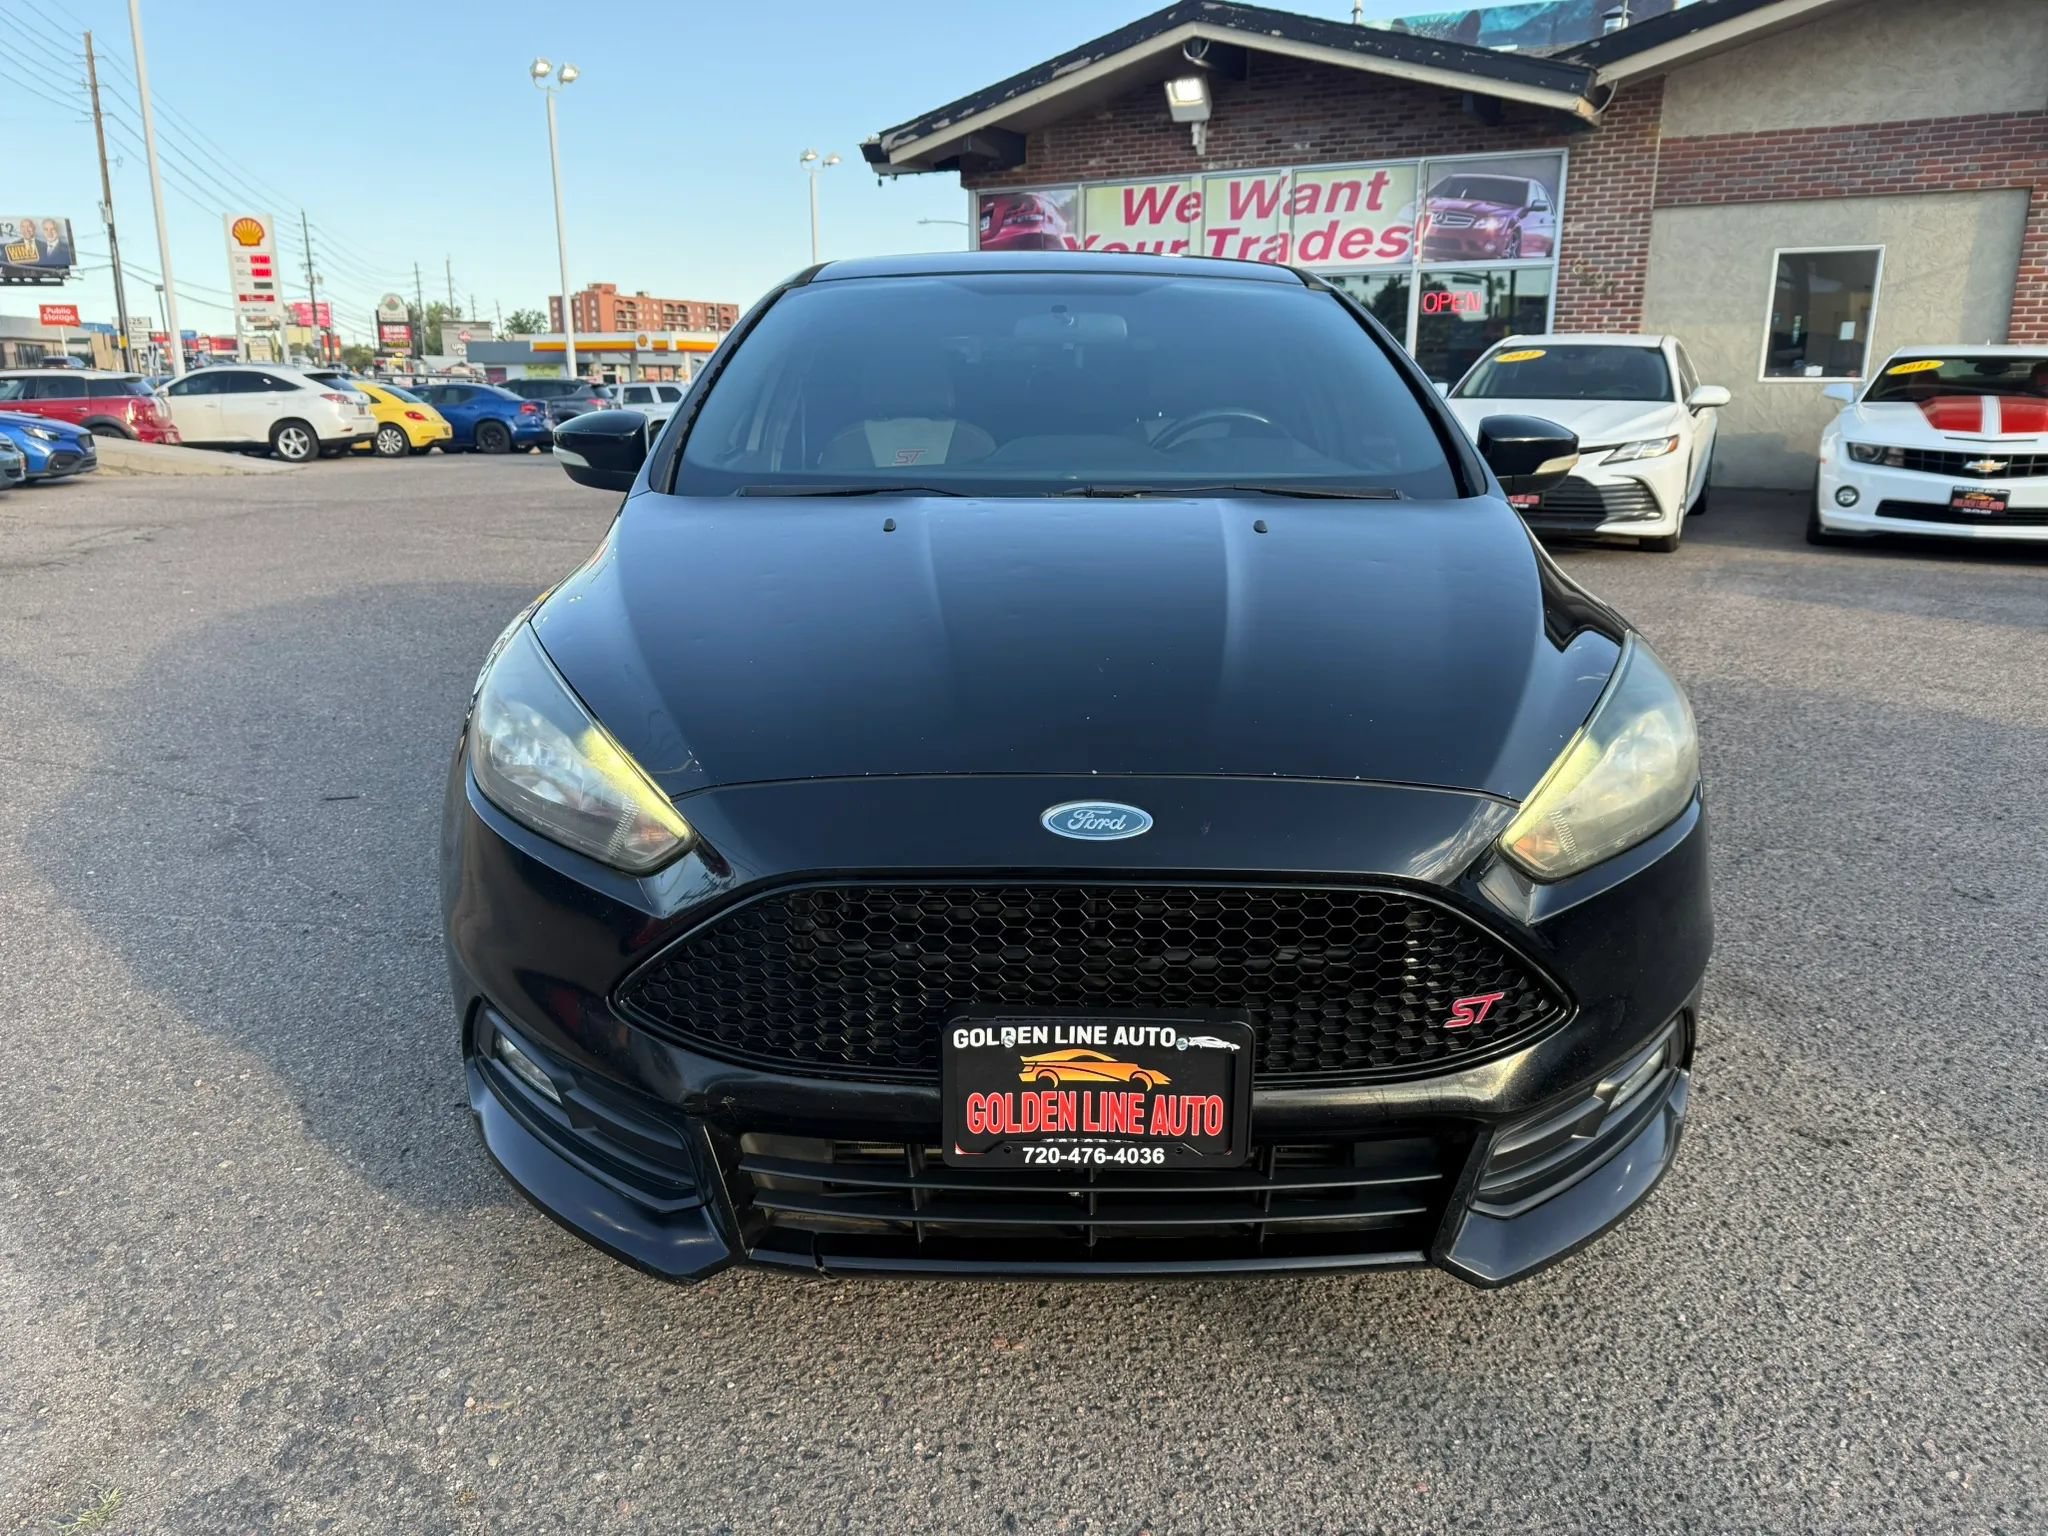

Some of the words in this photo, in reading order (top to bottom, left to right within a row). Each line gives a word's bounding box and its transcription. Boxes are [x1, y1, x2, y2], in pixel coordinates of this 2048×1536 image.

[1122, 184, 1202, 227] We
[1229, 169, 1391, 221] Want
[1206, 211, 1433, 264] Trades!
[45, 307, 72, 315] Public
[1423, 292, 1483, 314] OPEN
[43, 313, 76, 323] Storage
[895, 449, 928, 464] ST
[1067, 809, 1128, 830] Ford
[1442, 991, 1505, 1028] ST
[953, 1026, 1049, 1048] GOLDEN
[1054, 1025, 1108, 1045] LINE
[1112, 1025, 1177, 1048] AUTO
[966, 1090, 1077, 1135] GOLDEN
[1083, 1091, 1145, 1135] LINE
[1149, 1094, 1225, 1137] AUTO
[1022, 1146, 1166, 1165] 720-476-4036
